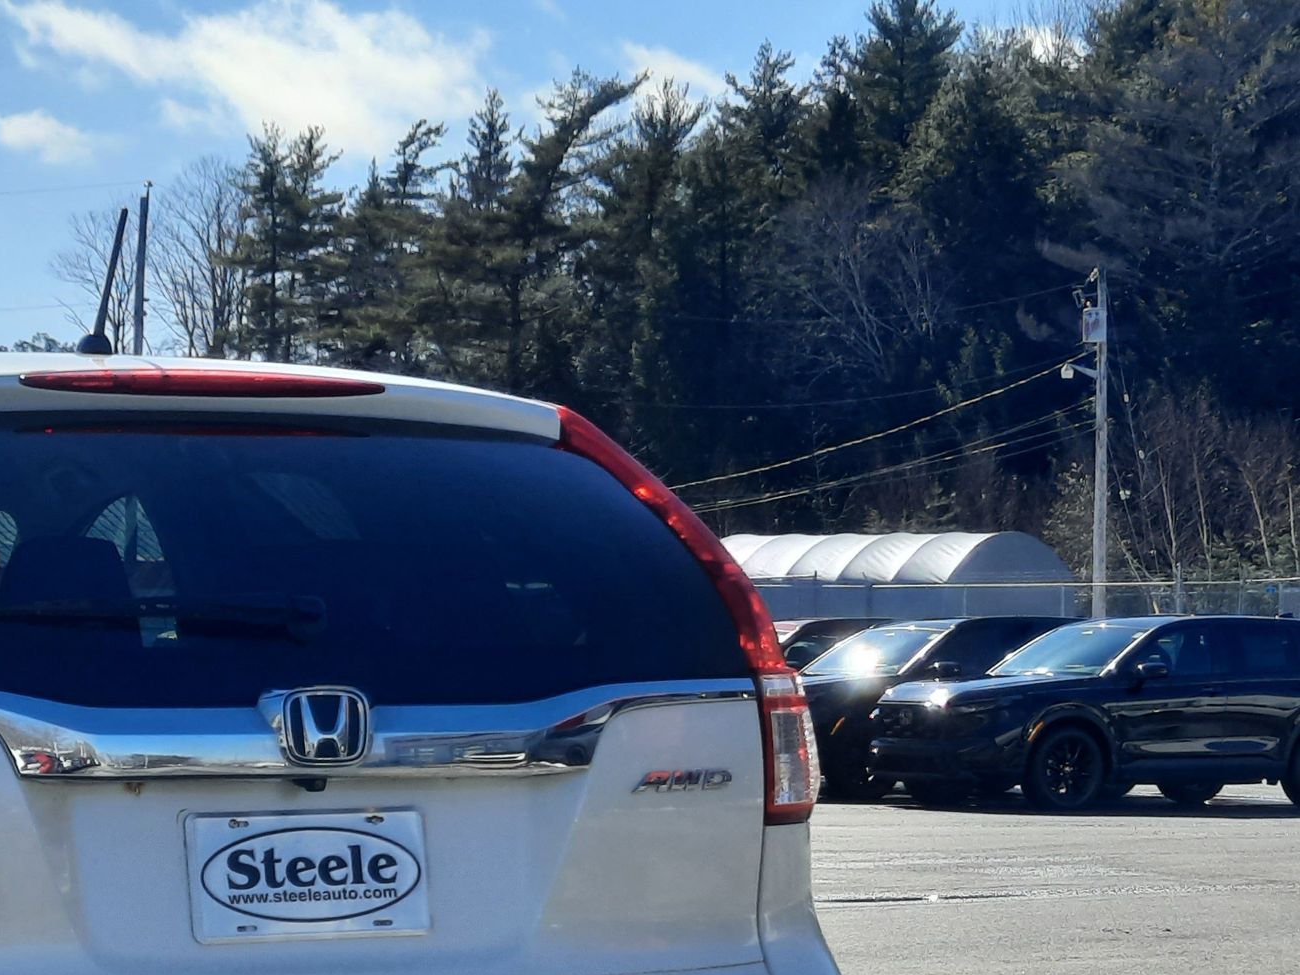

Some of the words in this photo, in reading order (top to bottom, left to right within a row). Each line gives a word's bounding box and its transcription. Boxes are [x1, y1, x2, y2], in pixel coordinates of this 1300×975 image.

[631, 768, 733, 794] AWD
[226, 844, 399, 890] Steele
[228, 887, 398, 905] www.steeleauto.com
